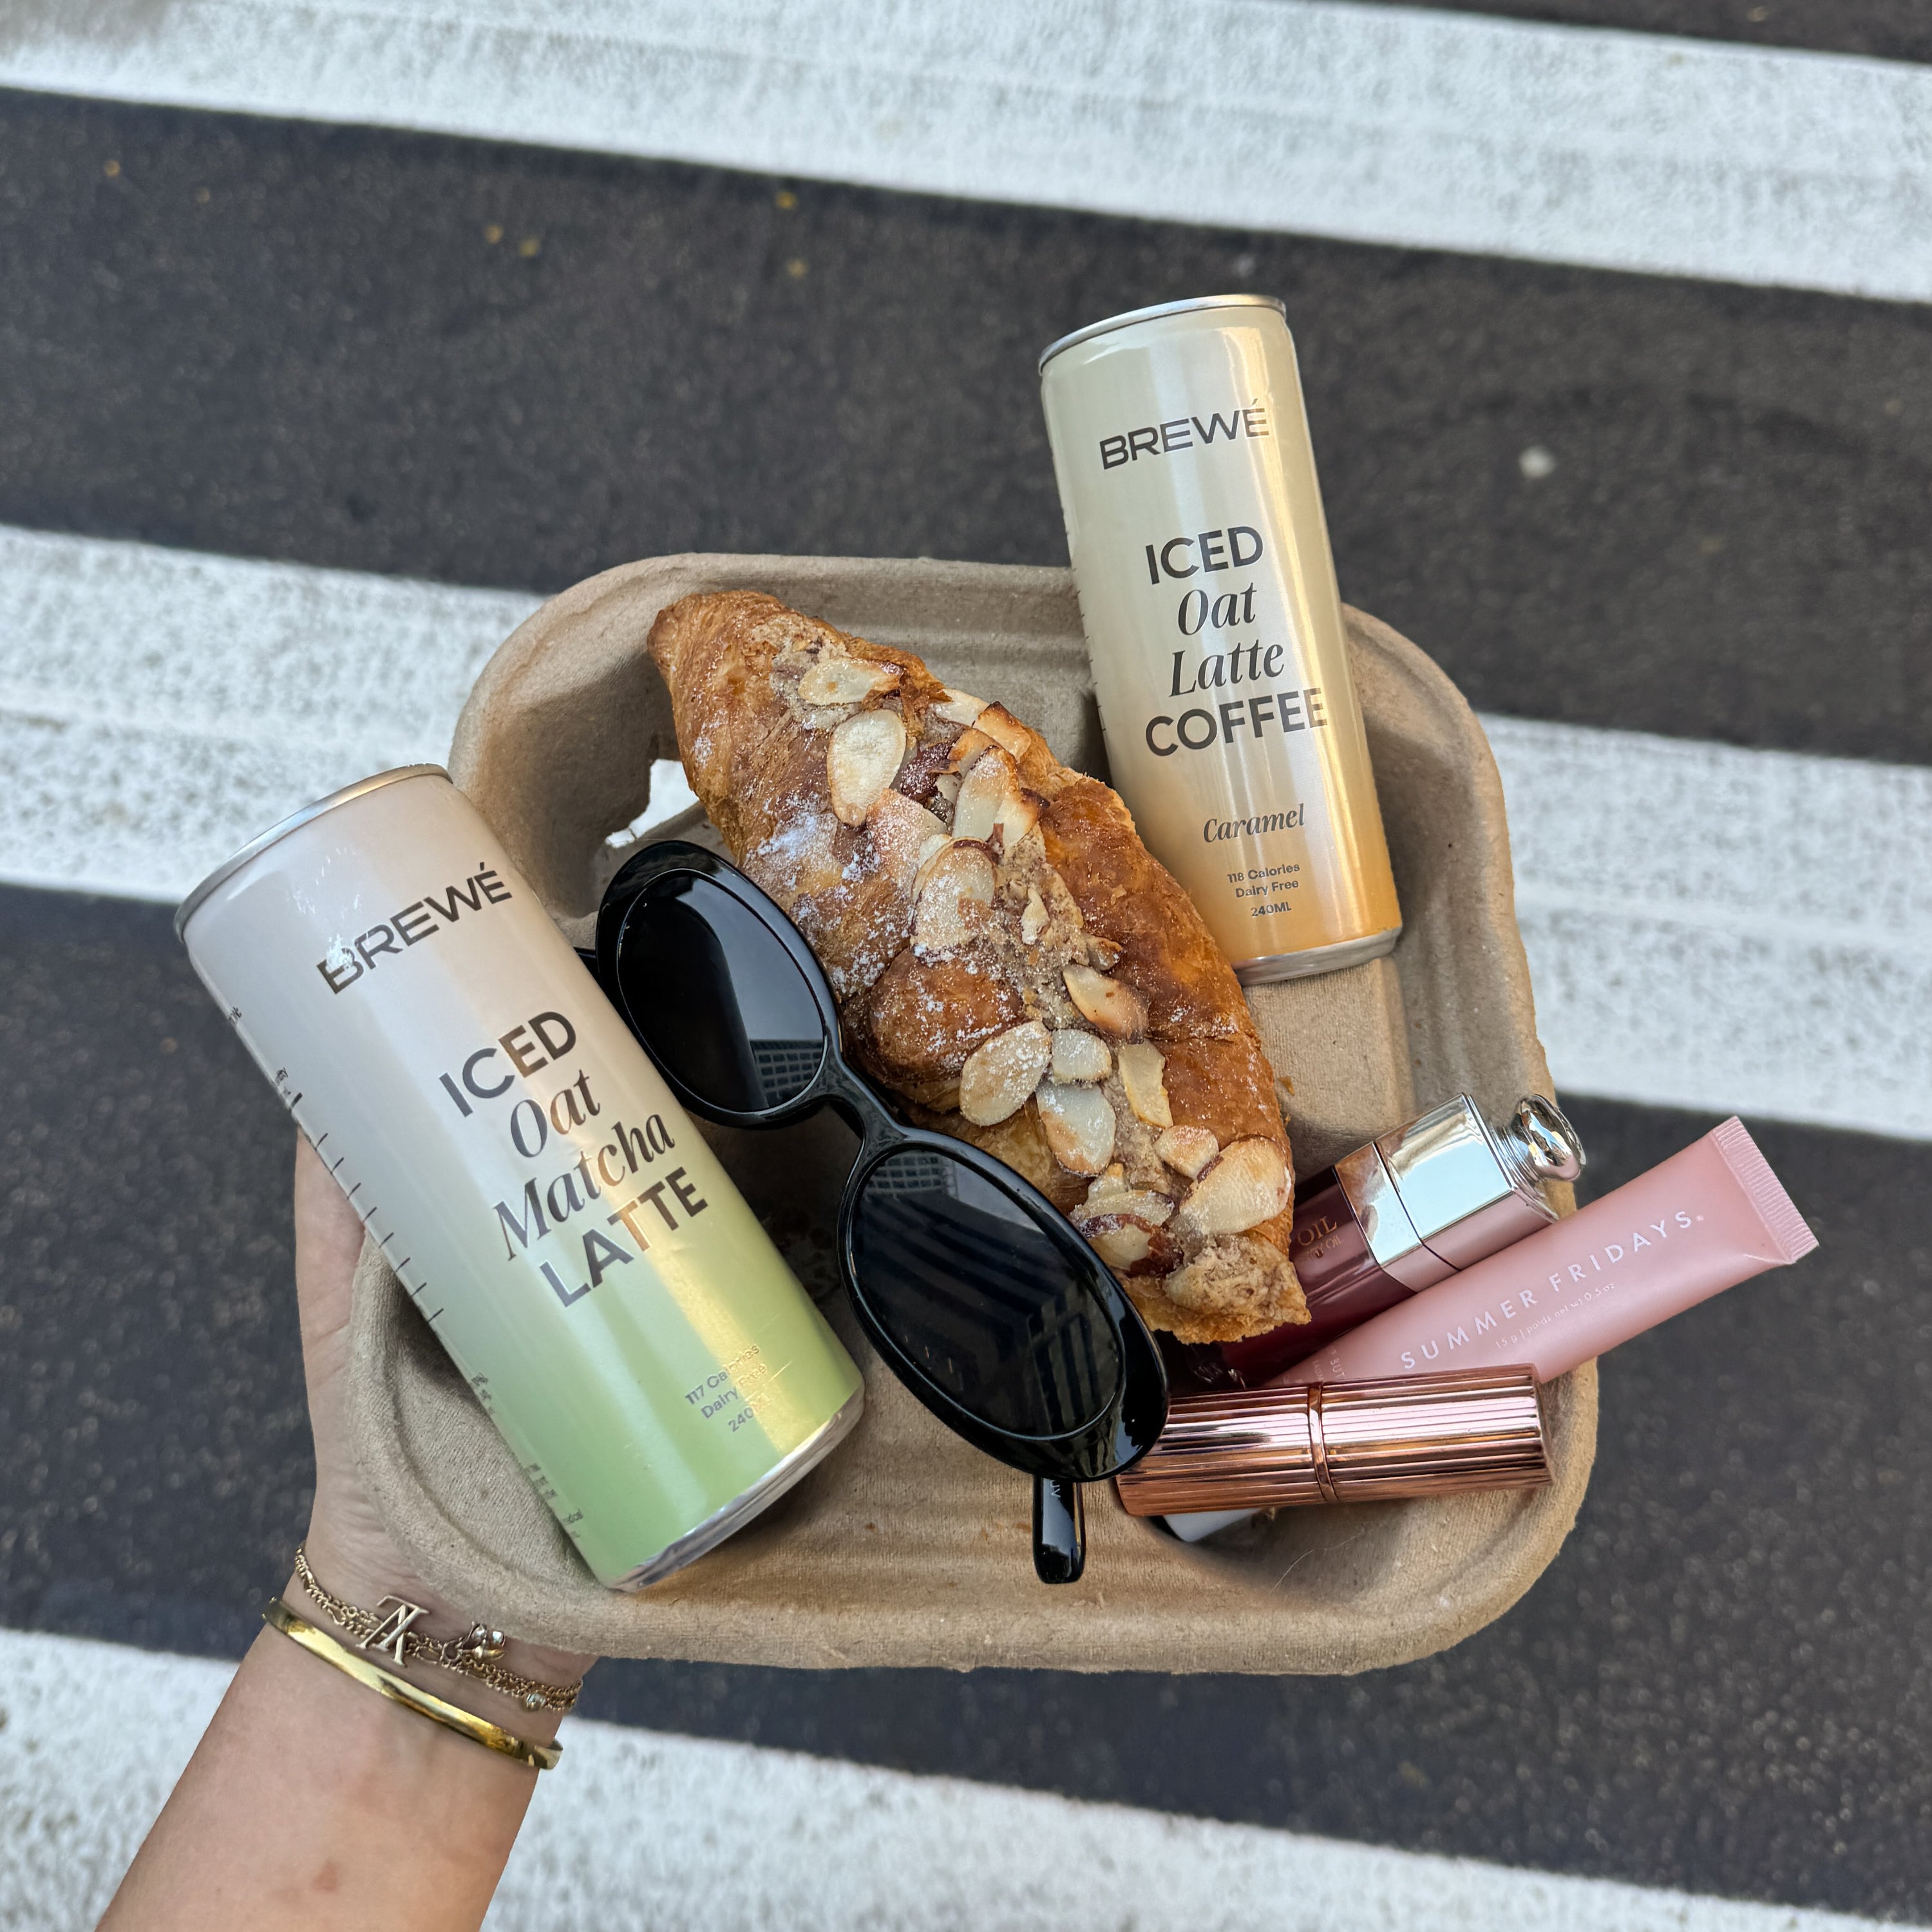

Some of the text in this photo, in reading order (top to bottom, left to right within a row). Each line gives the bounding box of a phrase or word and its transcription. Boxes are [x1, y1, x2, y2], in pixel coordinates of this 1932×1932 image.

[1099, 398, 1270, 470] BREWÉ
[1146, 526, 1264, 585] ICED
[1178, 582, 1258, 636] Oat
[1169, 639, 1285, 697] Latte
[1146, 687, 1328, 757] COFFEE
[1203, 803, 1305, 843] Caramel
[1227, 864, 1300, 883] 118 Calories
[1236, 880, 1299, 898] Dairy Free
[316, 862, 513, 994] BREWÉ
[1251, 902, 1292, 916] 240ML
[439, 1011, 577, 1118] ICED
[510, 1069, 601, 1159] Oat
[492, 1113, 676, 1262] Matcha
[540, 1166, 709, 1308] LATTE
[1297, 1216, 1337, 1247] OIL
[1401, 1289, 1538, 1369] SUMMER
[685, 1385, 705, 1405] 117
[701, 1388, 739, 1419] Dairy
